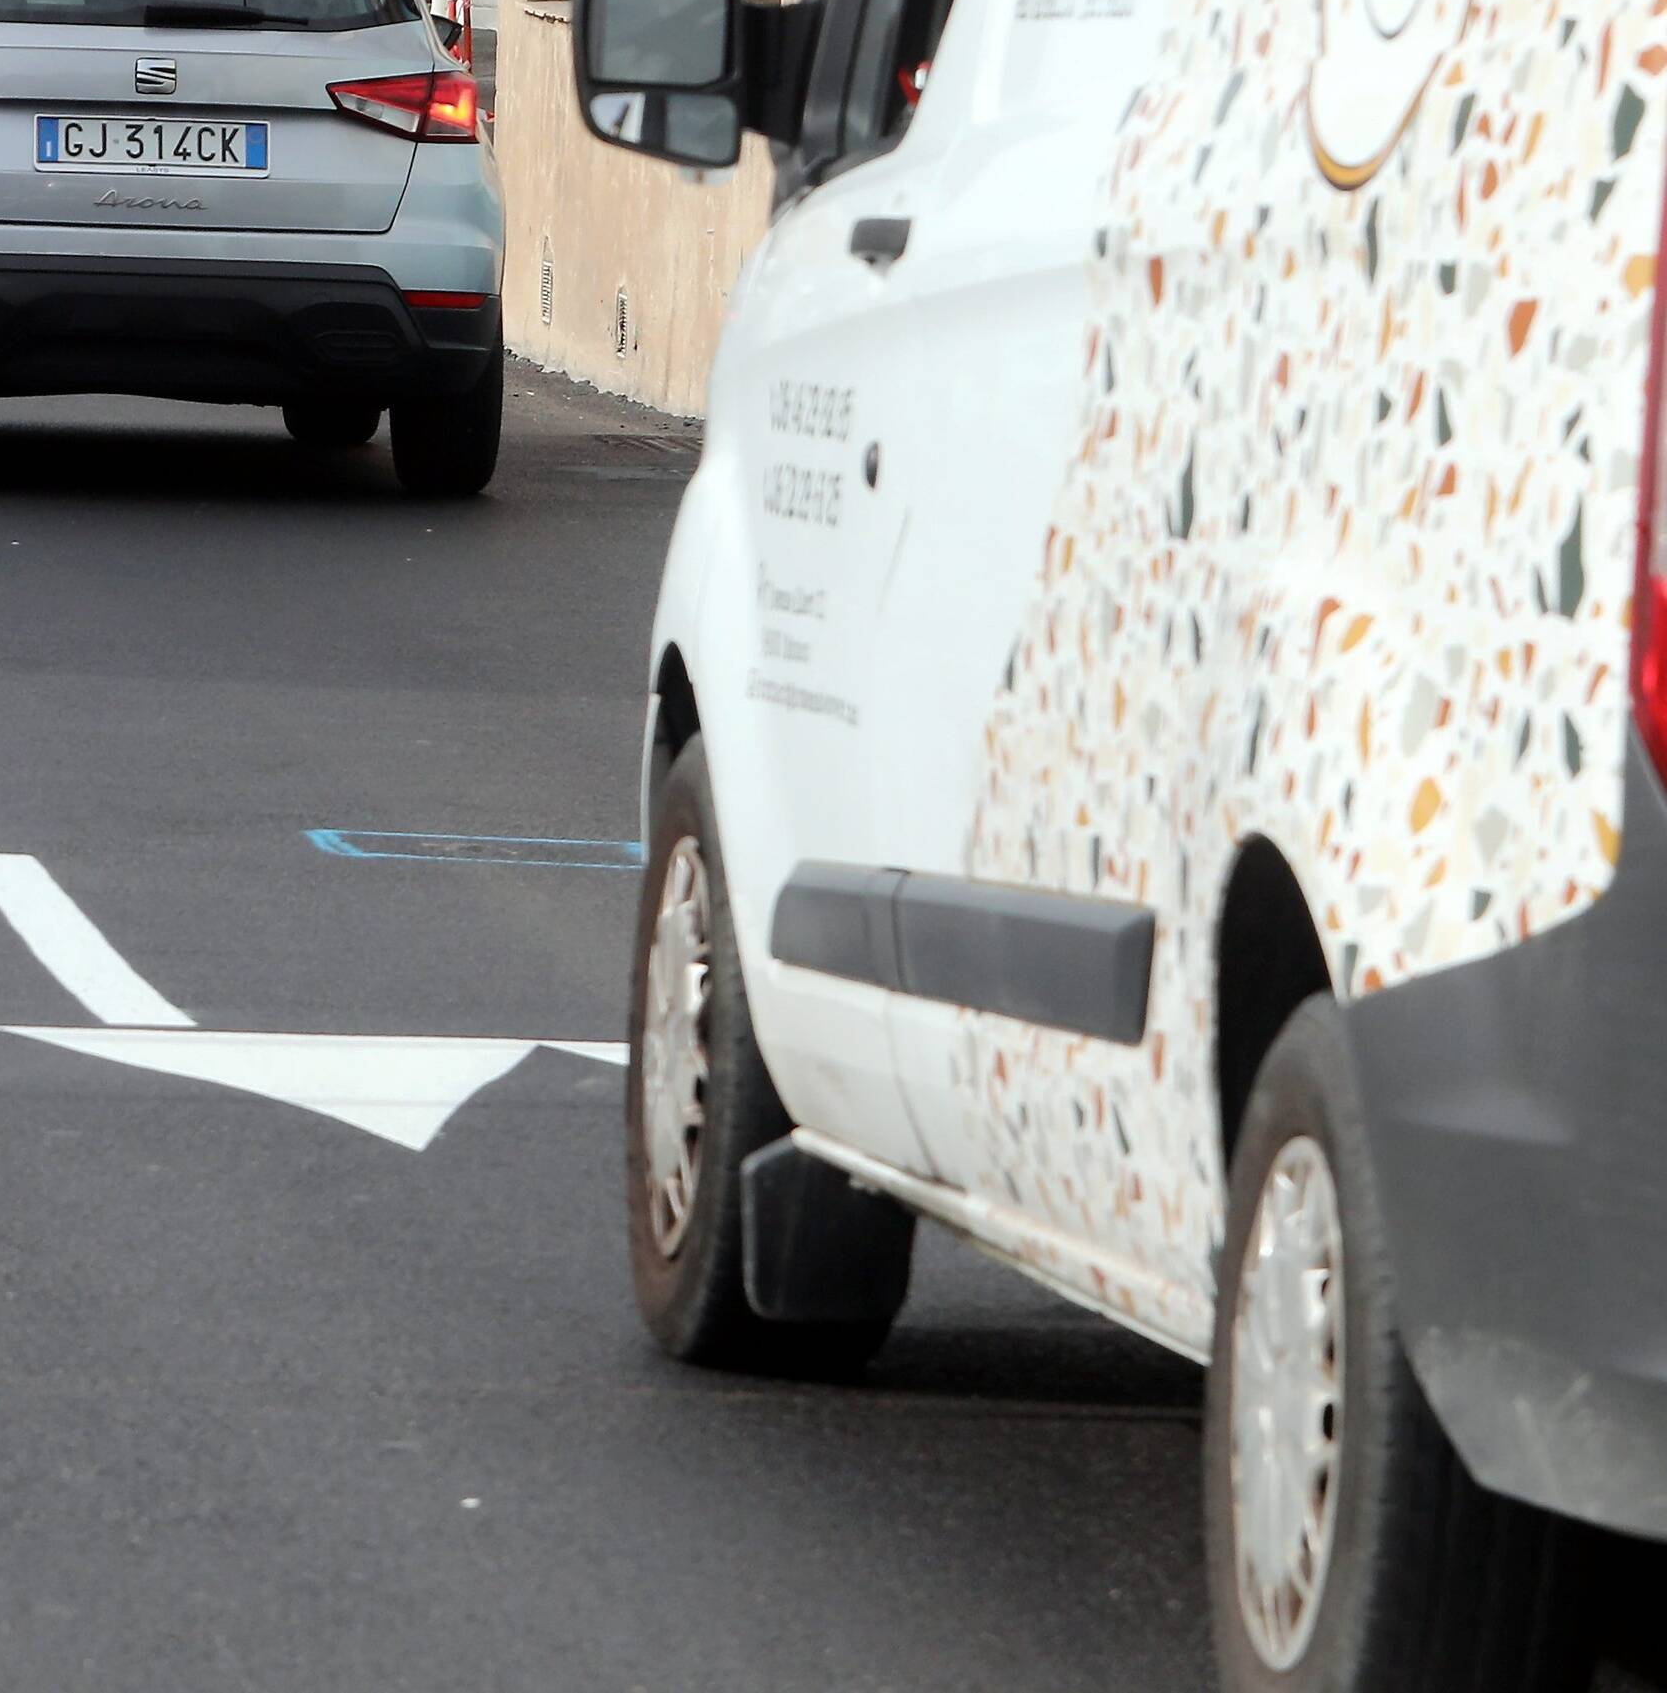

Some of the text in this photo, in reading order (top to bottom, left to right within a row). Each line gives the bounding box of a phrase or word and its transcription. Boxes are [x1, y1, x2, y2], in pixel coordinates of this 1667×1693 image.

[64, 122, 240, 163] GJ 314CK
[93, 189, 210, 211] Arona
